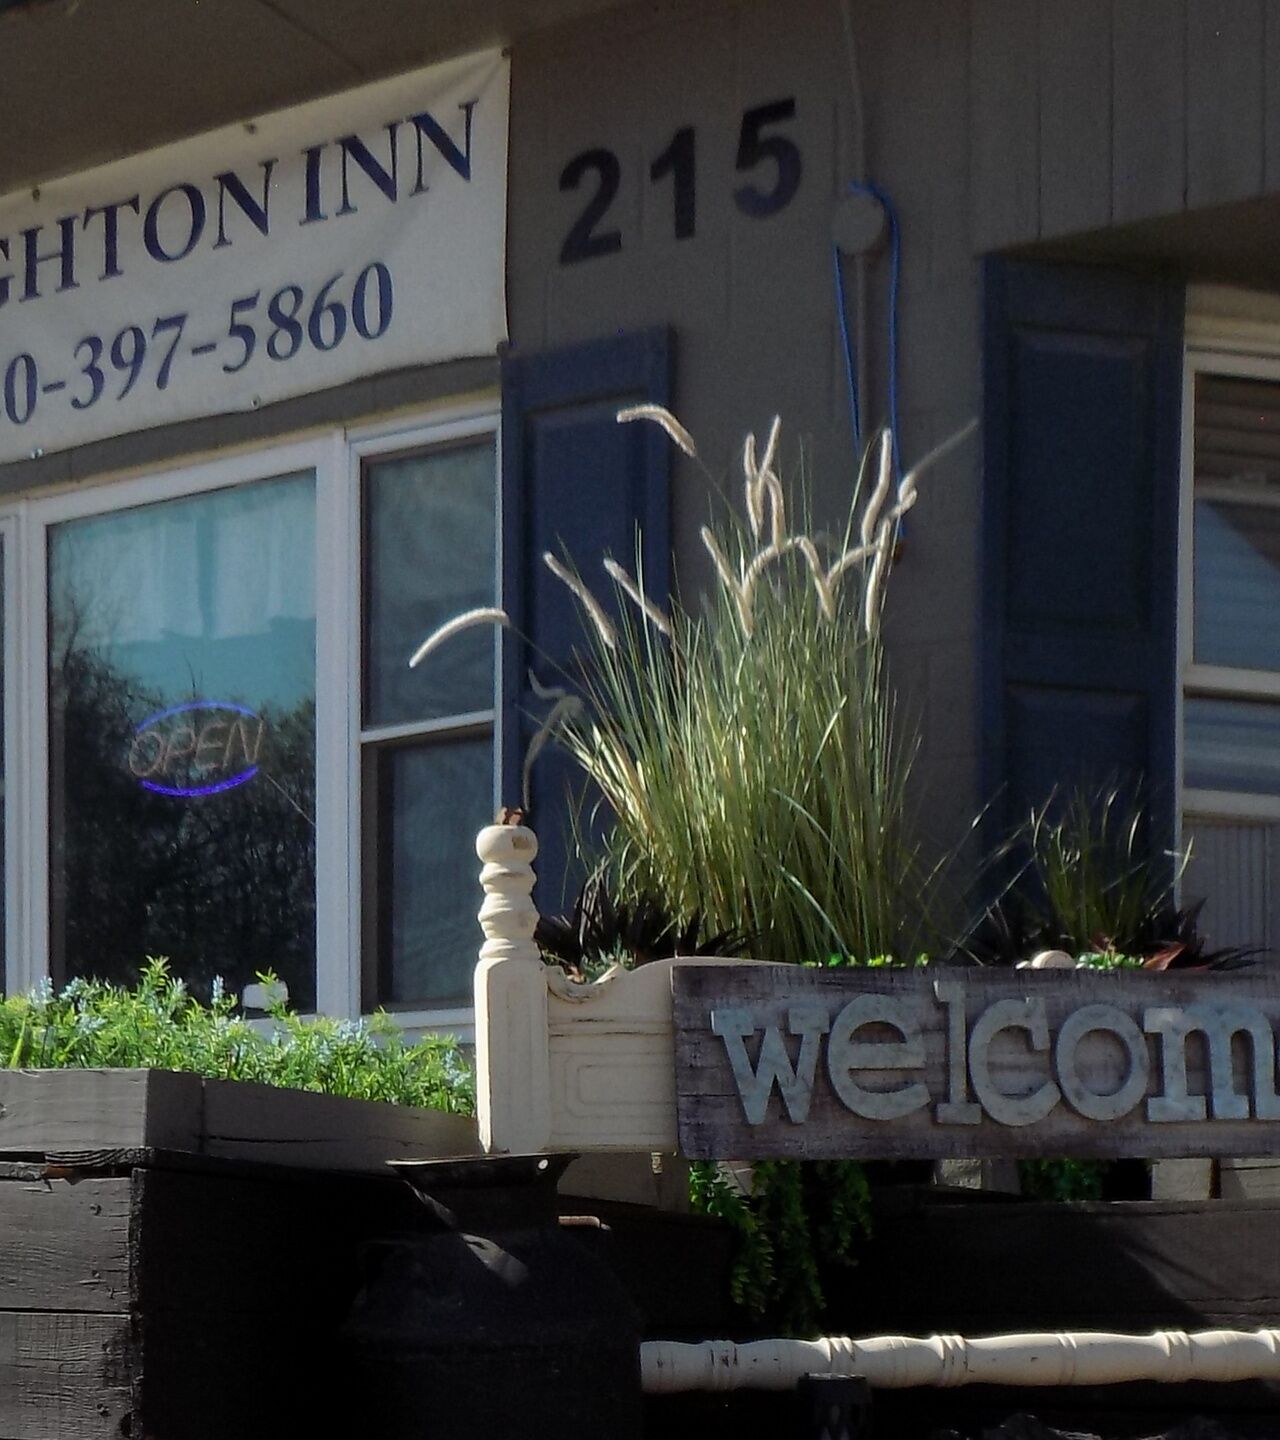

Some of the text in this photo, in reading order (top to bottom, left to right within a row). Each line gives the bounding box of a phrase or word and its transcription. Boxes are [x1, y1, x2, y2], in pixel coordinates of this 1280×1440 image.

[299, 100, 478, 226] INN
[559, 97, 801, 266] 215
[128, 717, 265, 777] OPEN
